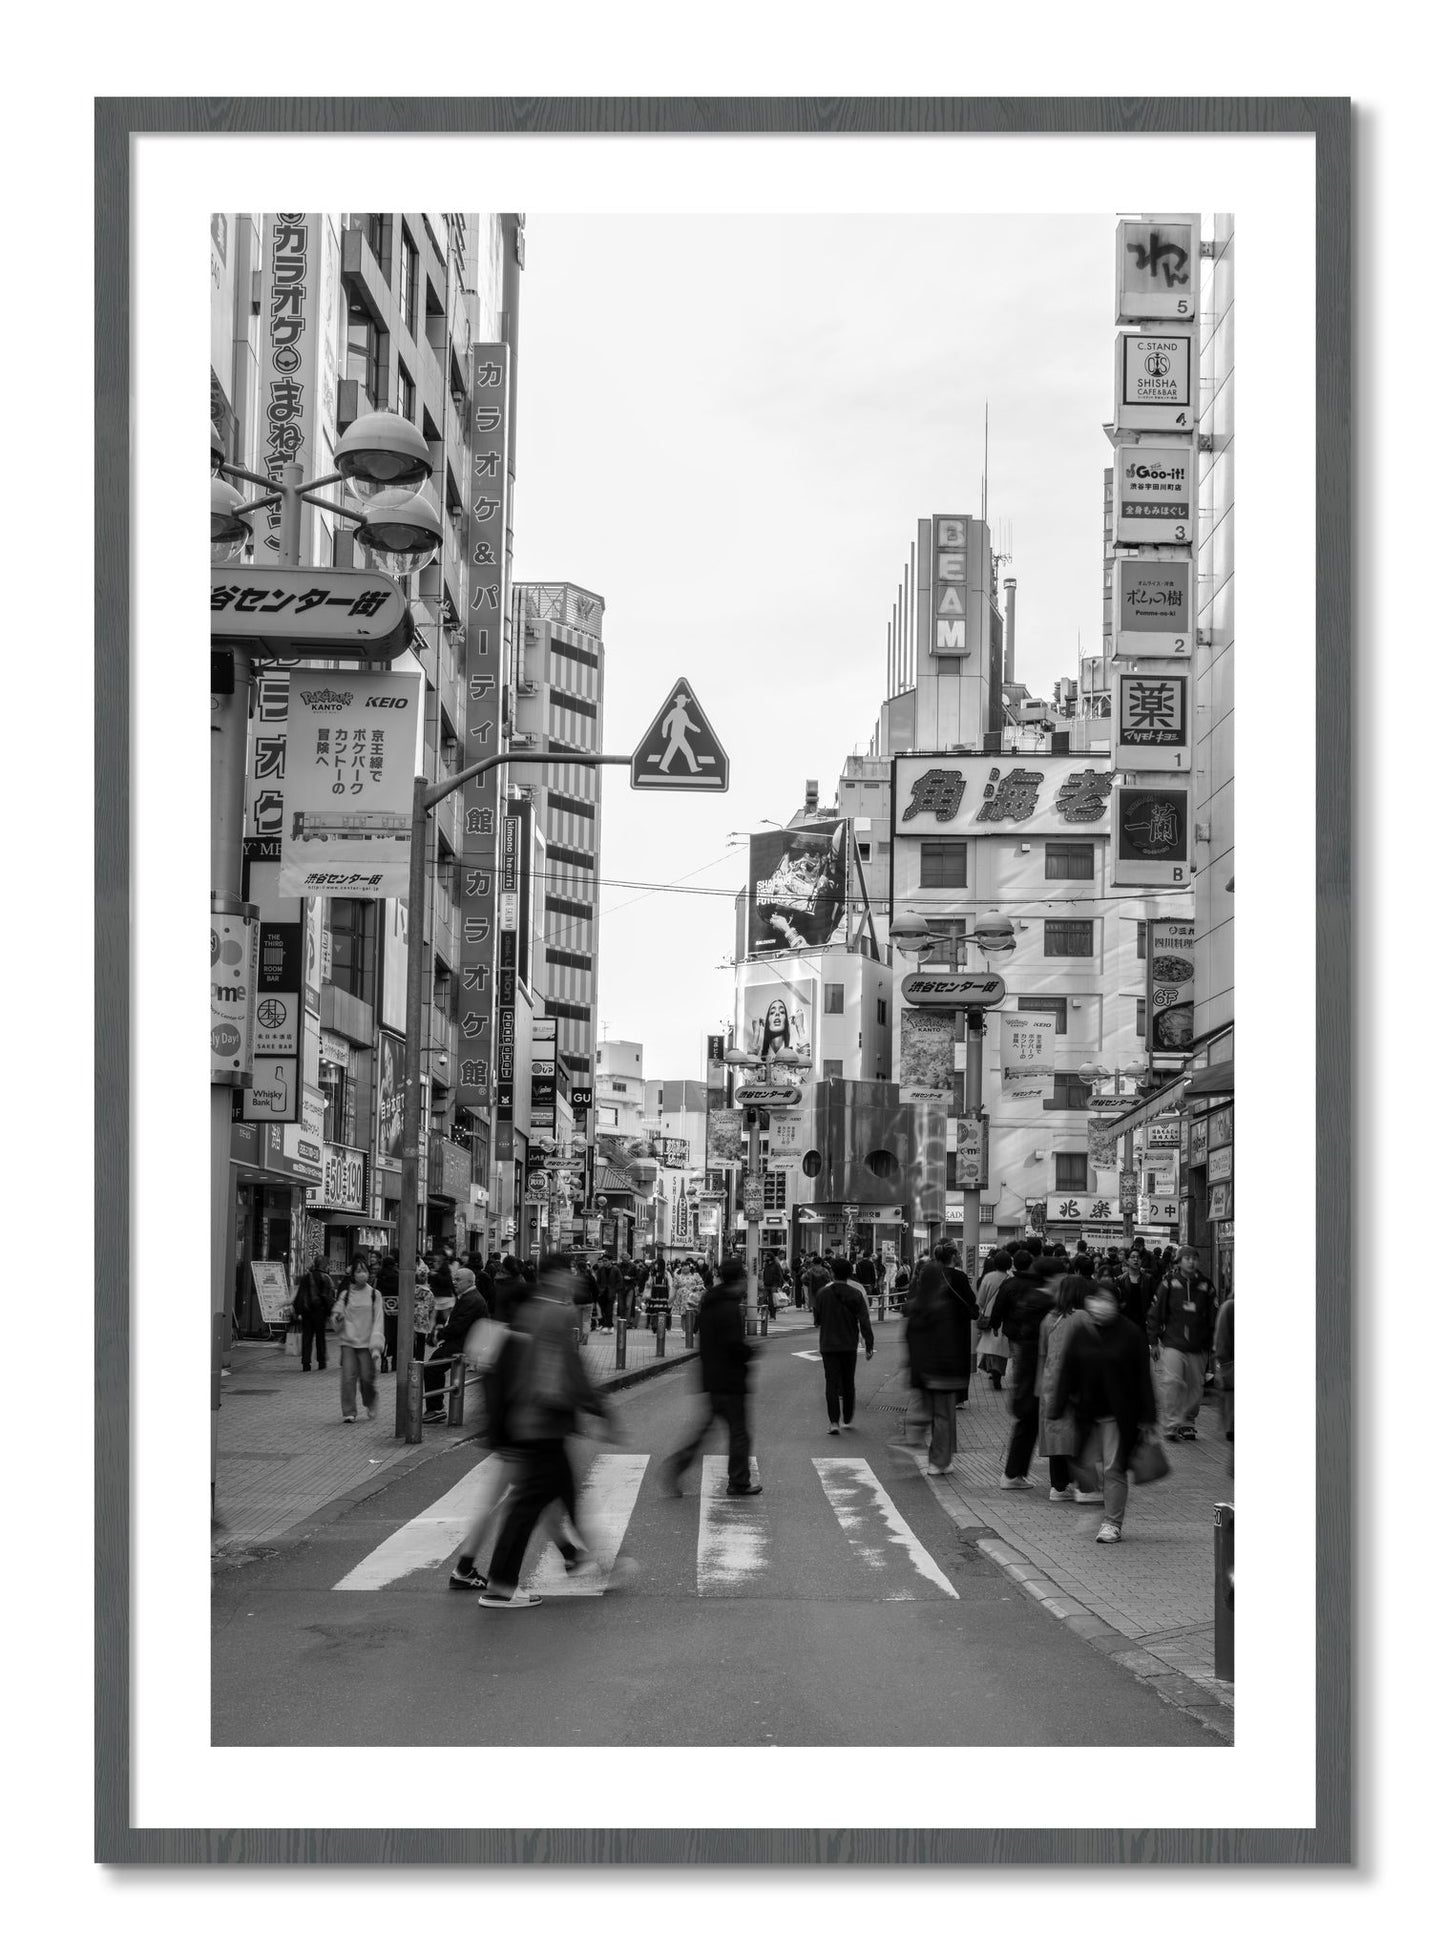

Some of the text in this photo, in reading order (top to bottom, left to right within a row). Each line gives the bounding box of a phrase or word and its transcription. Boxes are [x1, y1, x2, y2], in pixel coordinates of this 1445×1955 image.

[270, 224, 307, 347] カラオケ
[1177, 300, 1188, 313] 5
[1137, 342, 1178, 351] C.STAND
[1137, 378, 1177, 388] SHISHA
[1176, 412, 1187, 426] 4
[1136, 465, 1185, 480] Goo-it!
[1125, 505, 1186, 516] 全身もみほぐし
[1175, 525, 1186, 540] 3
[937, 519, 967, 648] BEAM
[1174, 638, 1185, 653] 2
[365, 696, 409, 709] KEIO
[1129, 682, 1175, 728] 薬
[315, 728, 330, 767] 冒険へ
[331, 728, 349, 795] カントーの
[369, 730, 385, 783] 京王線で
[1174, 753, 1181, 767] 1
[304, 873, 383, 885] 渋谷センター街
[1173, 867, 1184, 881] B
[460, 871, 494, 1086] カラオケ館
[908, 981, 999, 993] 渋谷センター街
[1154, 989, 1178, 1007] 6F
[253, 1090, 283, 1100] Whisky
[573, 1093, 592, 1103] GU
